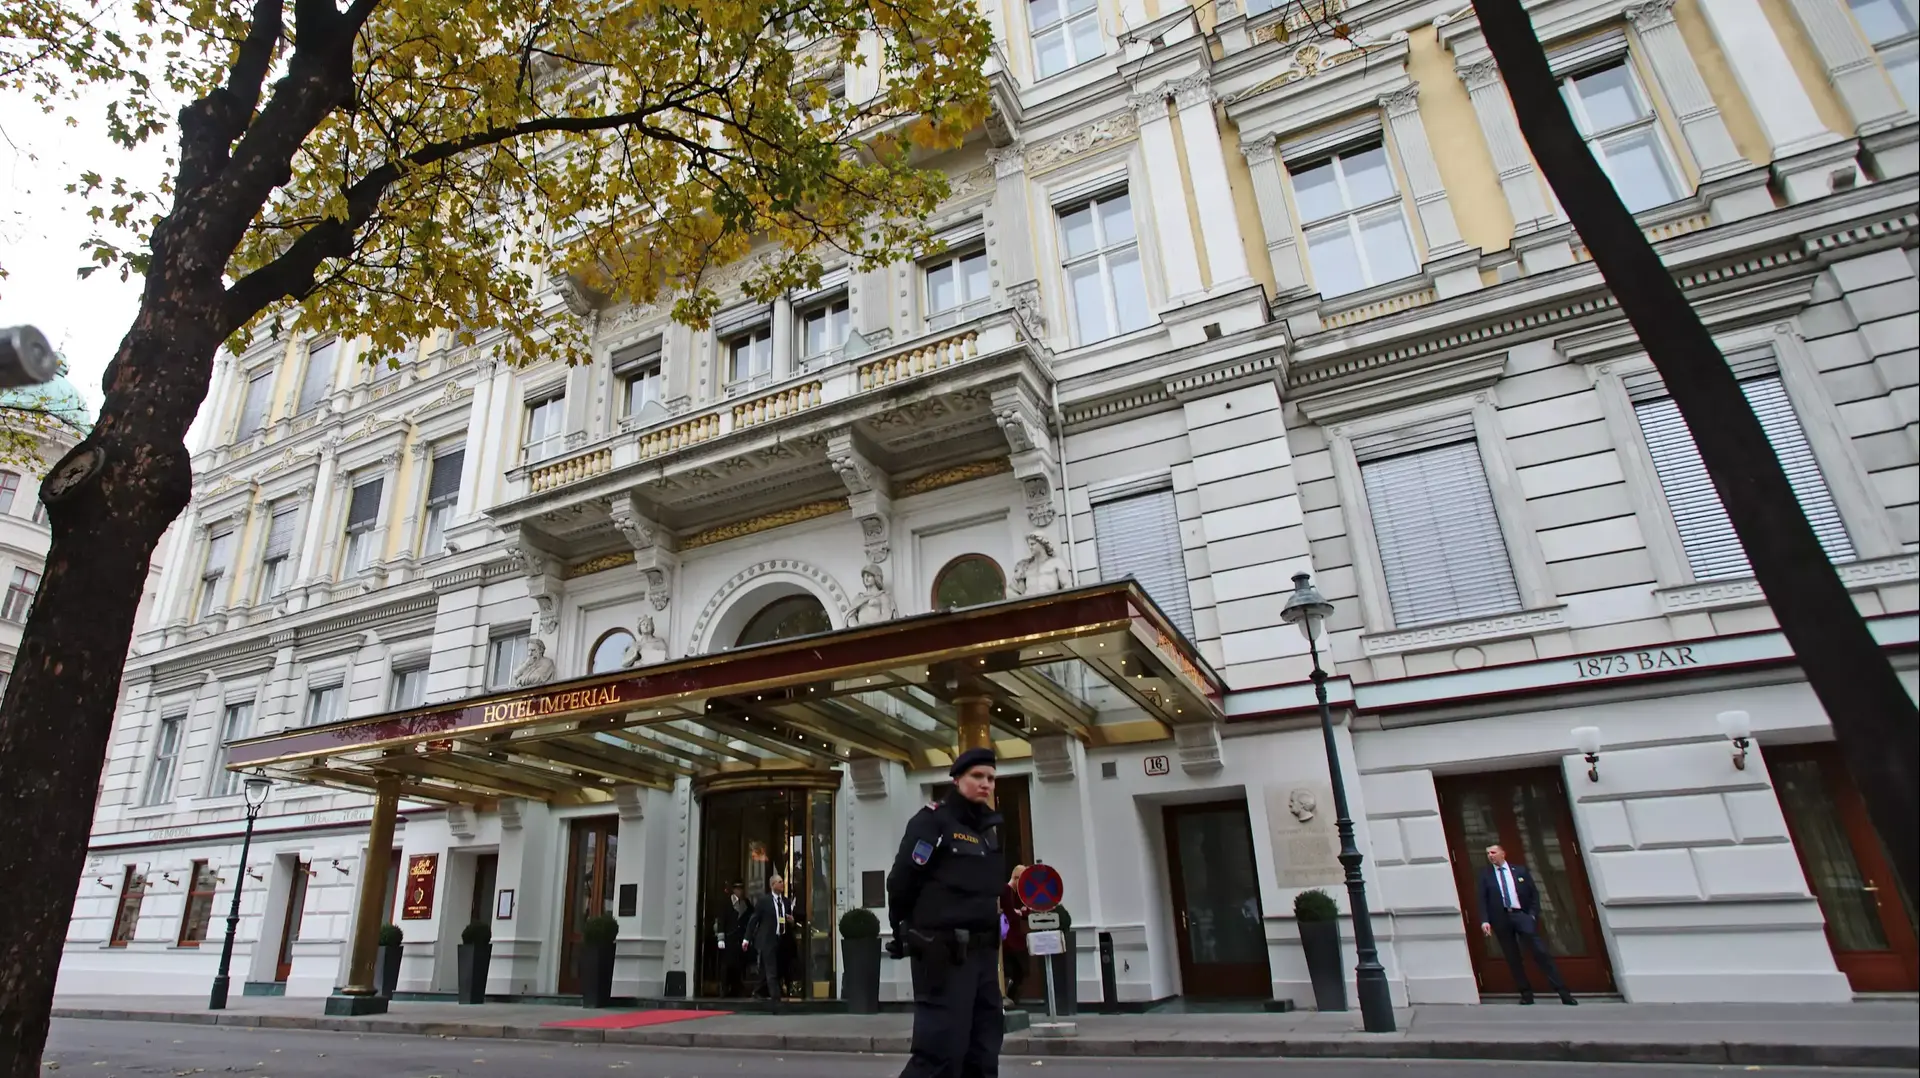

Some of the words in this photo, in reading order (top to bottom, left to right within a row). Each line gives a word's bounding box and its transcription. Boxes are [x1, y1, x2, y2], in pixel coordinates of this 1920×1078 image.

[1573, 655, 1629, 678] 1873
[1634, 646, 1698, 671] BAR
[483, 699, 536, 723] HOTEL
[539, 685, 621, 714] IMPERIAL
[1150, 757, 1163, 770] 16
[953, 832, 979, 844] POLIZEI
